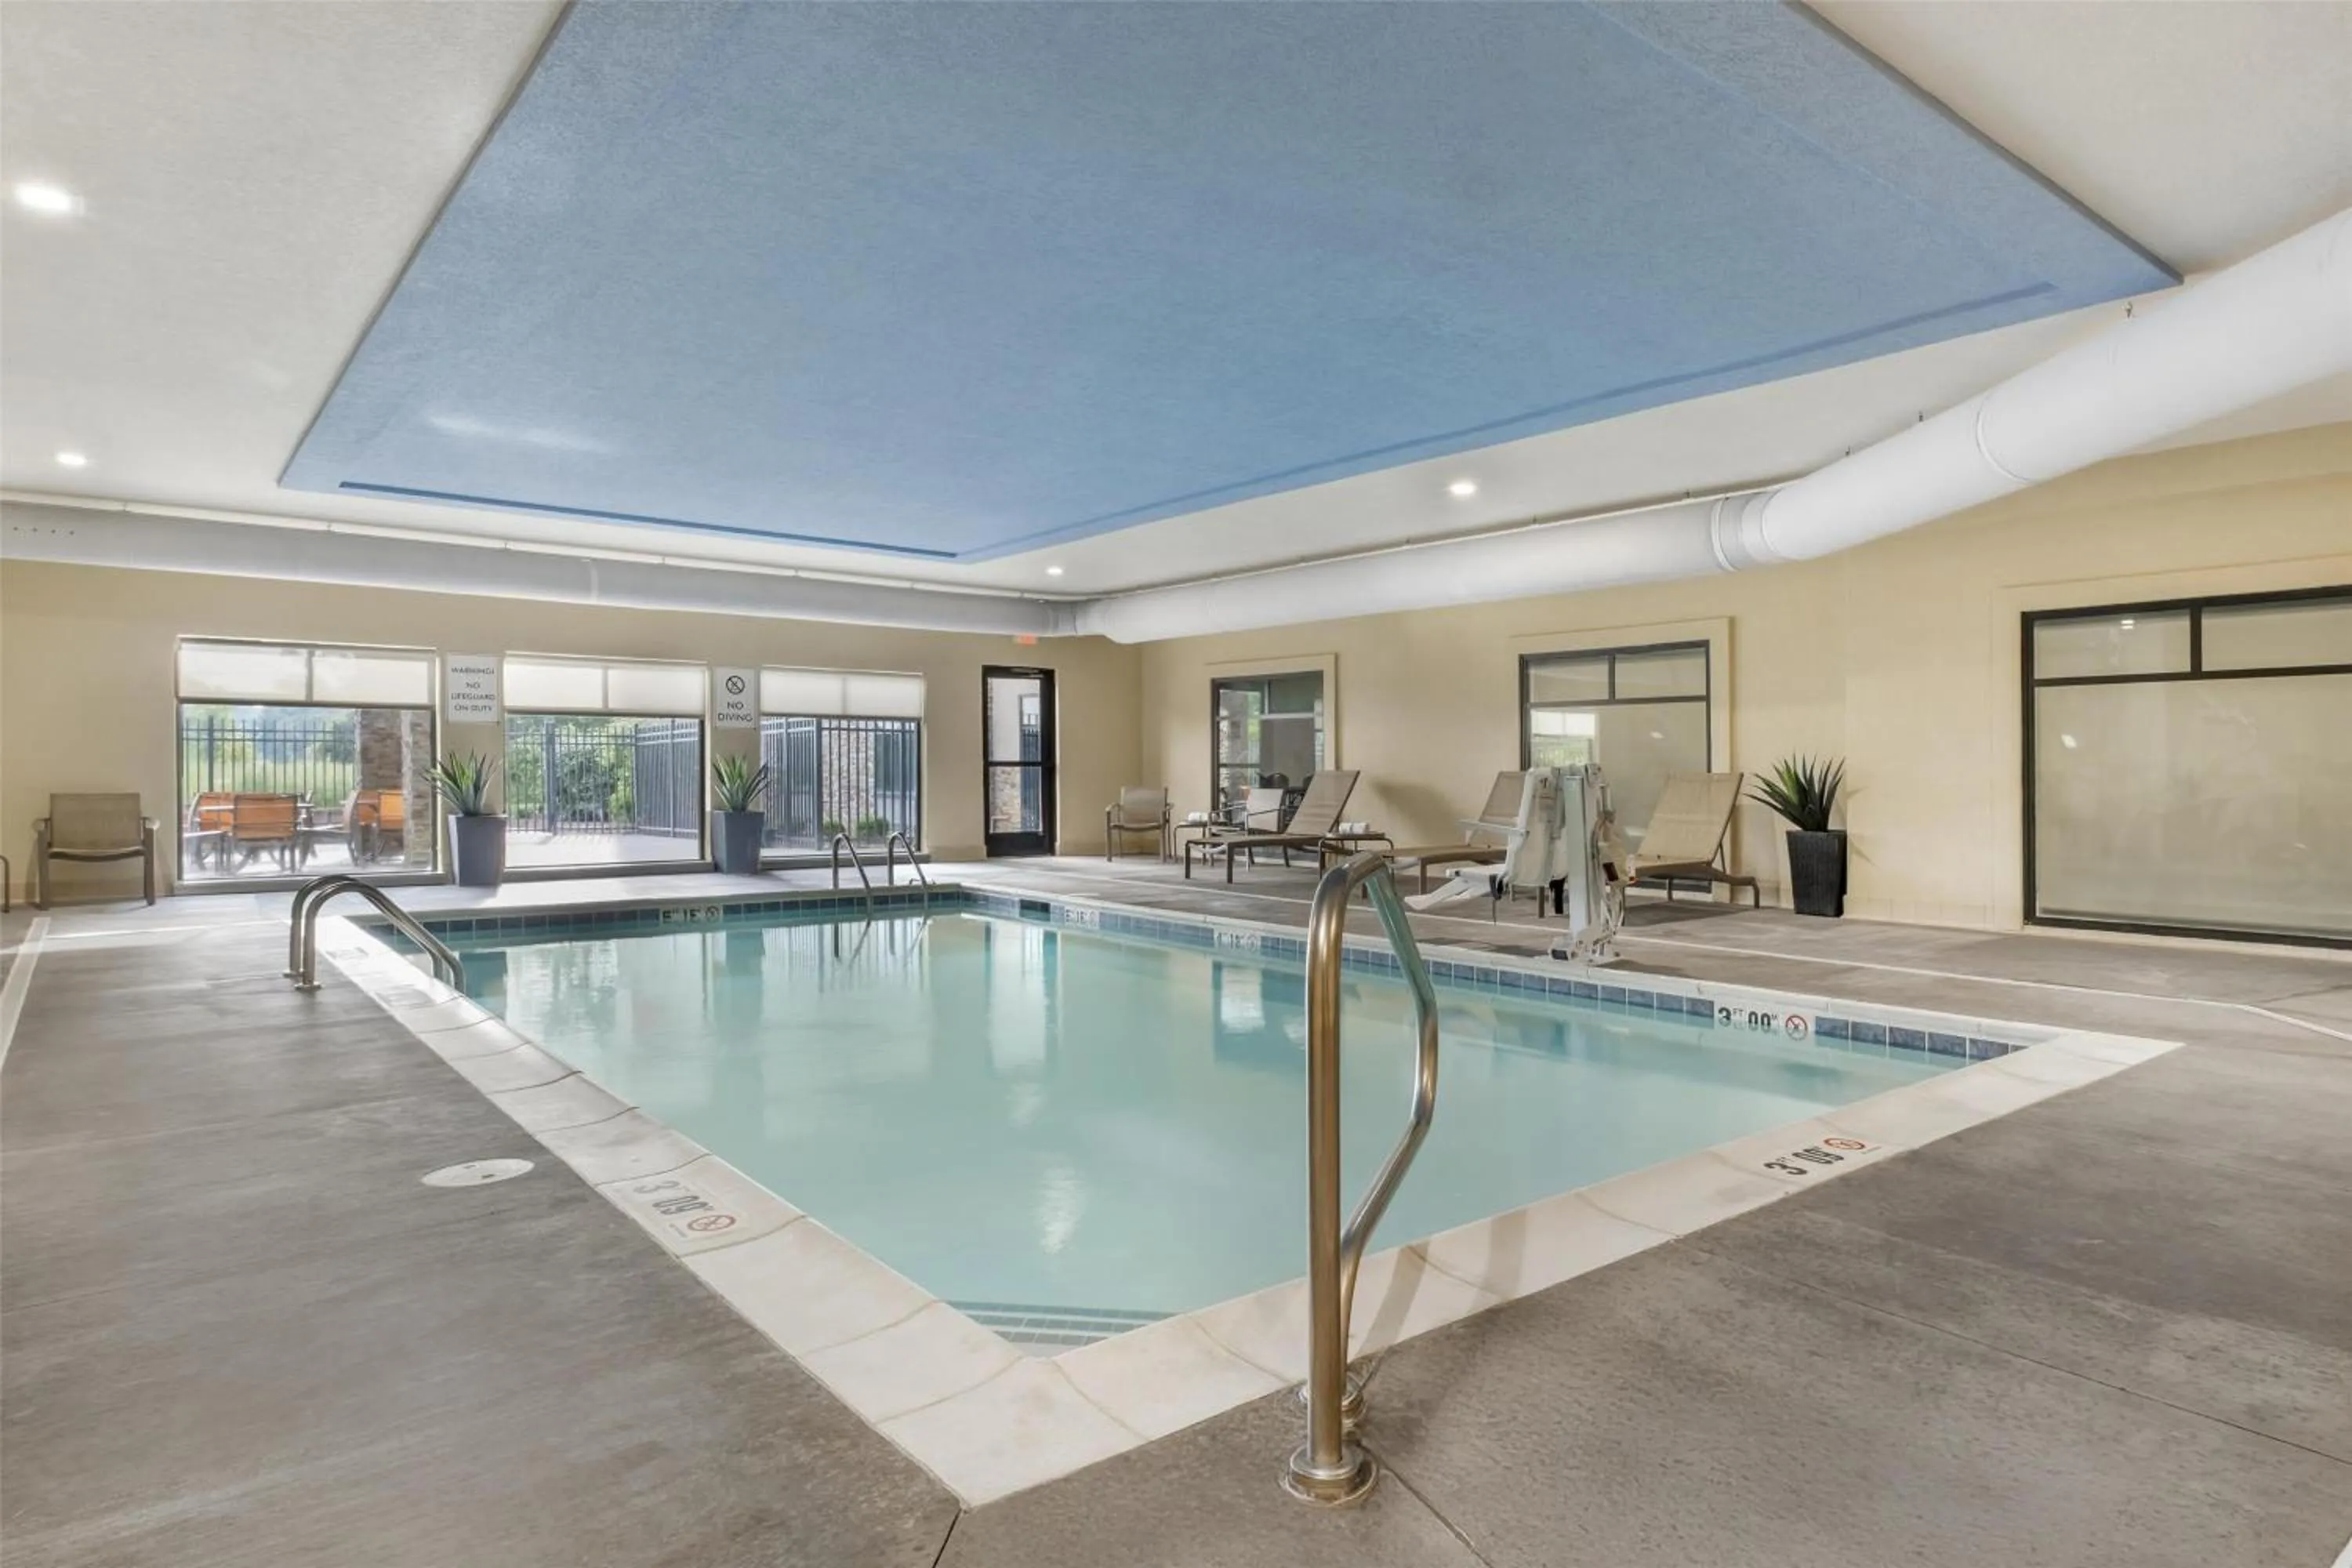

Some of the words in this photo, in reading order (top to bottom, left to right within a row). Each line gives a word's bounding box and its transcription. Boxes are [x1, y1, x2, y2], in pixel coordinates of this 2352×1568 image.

[451, 692, 495, 701] LIFEGUARD
[470, 704, 493, 713] DUTY
[727, 701, 744, 710] NO
[717, 712, 753, 722] DIVING
